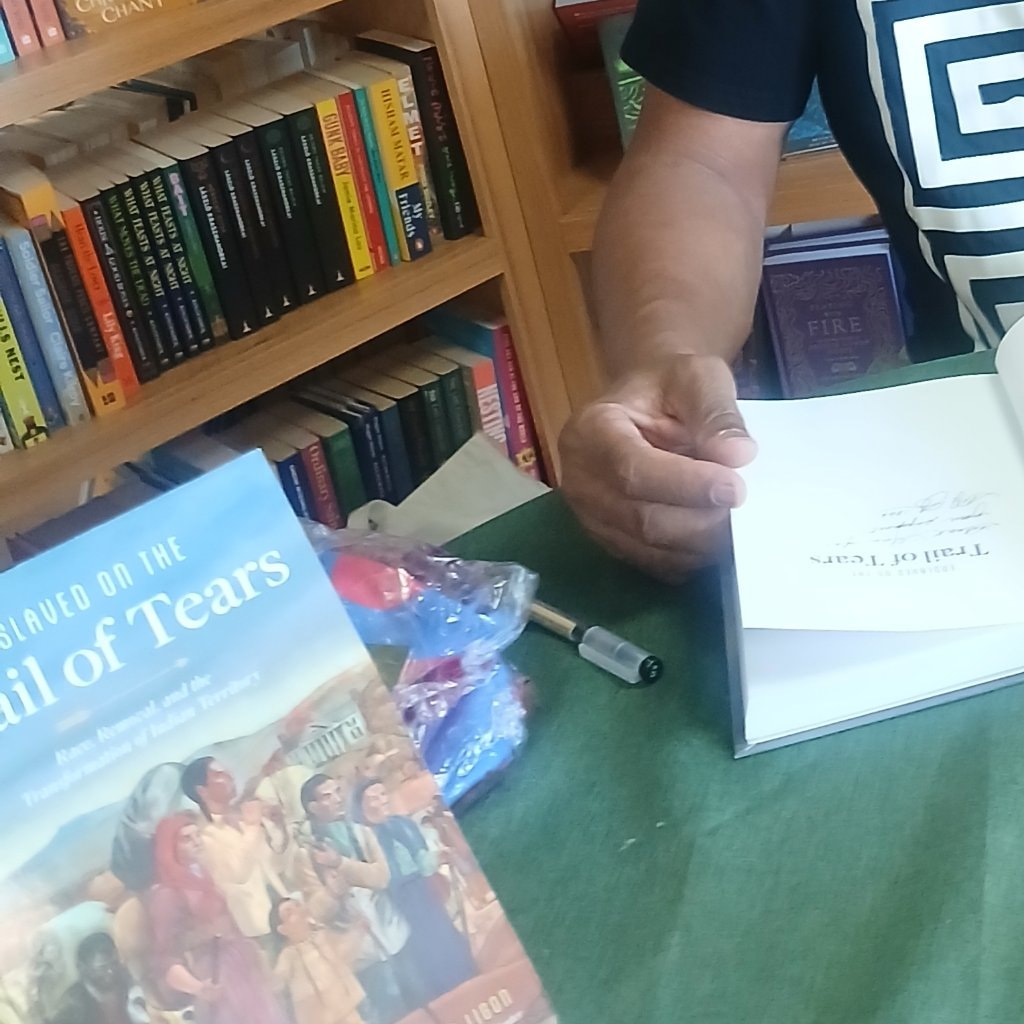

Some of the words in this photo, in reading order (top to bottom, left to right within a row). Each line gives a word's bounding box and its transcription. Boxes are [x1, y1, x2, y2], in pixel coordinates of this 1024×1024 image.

[320, 112, 343, 146] GUNK
[399, 77, 423, 157] ELMET
[379, 88, 401, 137] HISHAM
[391, 139, 411, 181] MATAR
[329, 146, 351, 177] BABY
[122, 187, 139, 216] WHAT
[138, 181, 154, 208] WHAT
[151, 175, 168, 205] WHAT
[160, 205, 178, 240] FEASTS
[396, 192, 419, 238] Friends
[408, 201, 425, 221] My
[131, 217, 150, 252] FEASTS
[147, 211, 165, 245] FEASTS
[143, 255, 154, 266] AT
[159, 248, 169, 259] AT
[171, 241, 182, 253] AT
[16, 240, 41, 287] Soldier
[32, 287, 54, 325] Sailor
[148, 269, 164, 297] NIGHT
[163, 262, 179, 290] NIGHT
[175, 255, 192, 285] NIGHT
[99, 311, 116, 332] Lily
[807, 317, 863, 336] FIRE
[106, 332, 124, 360] King
[5, 347, 24, 382] NEST
[809, 555, 884, 566] Tears
[890, 552, 917, 566] of
[923, 543, 989, 563] Trail
[0, 584, 92, 647] SLAVED
[97, 562, 133, 600] ON
[151, 535, 187, 574] THE
[0, 656, 60, 733] ail
[62, 618, 128, 689] of
[126, 547, 292, 651] Tears
[159, 684, 191, 708] and
[188, 670, 214, 692] the
[18, 741, 137, 808] Transformation
[130, 727, 153, 748] of
[147, 705, 197, 738] Indian
[195, 669, 264, 711] Territory
